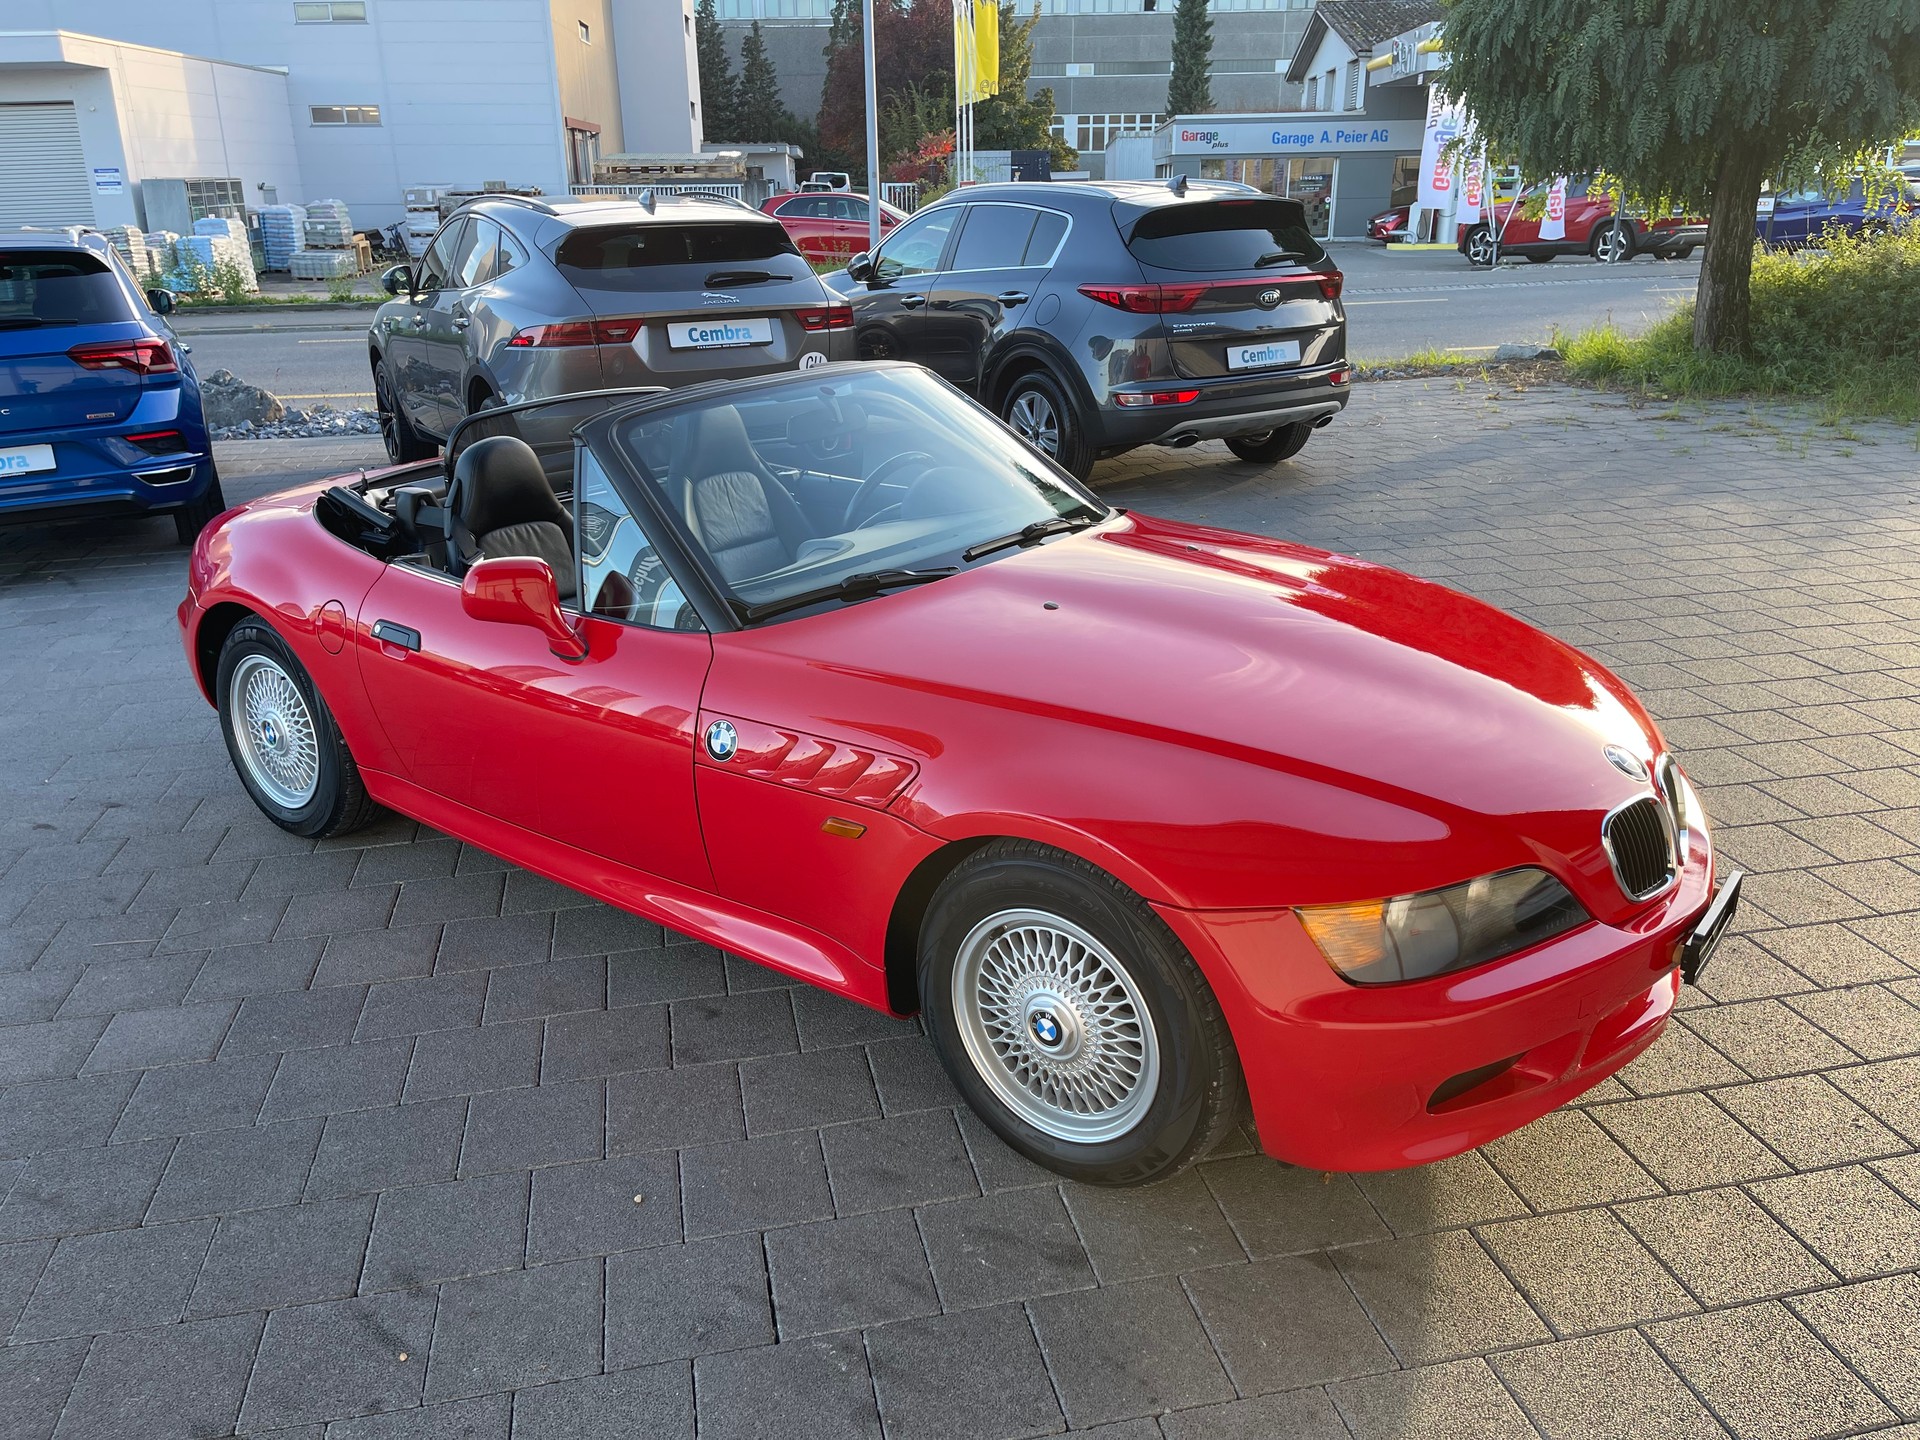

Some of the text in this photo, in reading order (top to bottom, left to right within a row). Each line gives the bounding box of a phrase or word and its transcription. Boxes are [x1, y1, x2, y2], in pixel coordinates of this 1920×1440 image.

[1181, 130, 1219, 144] Garage
[1212, 141, 1229, 149] plus
[1272, 129, 1389, 147] Garage A. Peier AG
[688, 324, 752, 343] Cembra
[1241, 346, 1287, 363] Cembra
